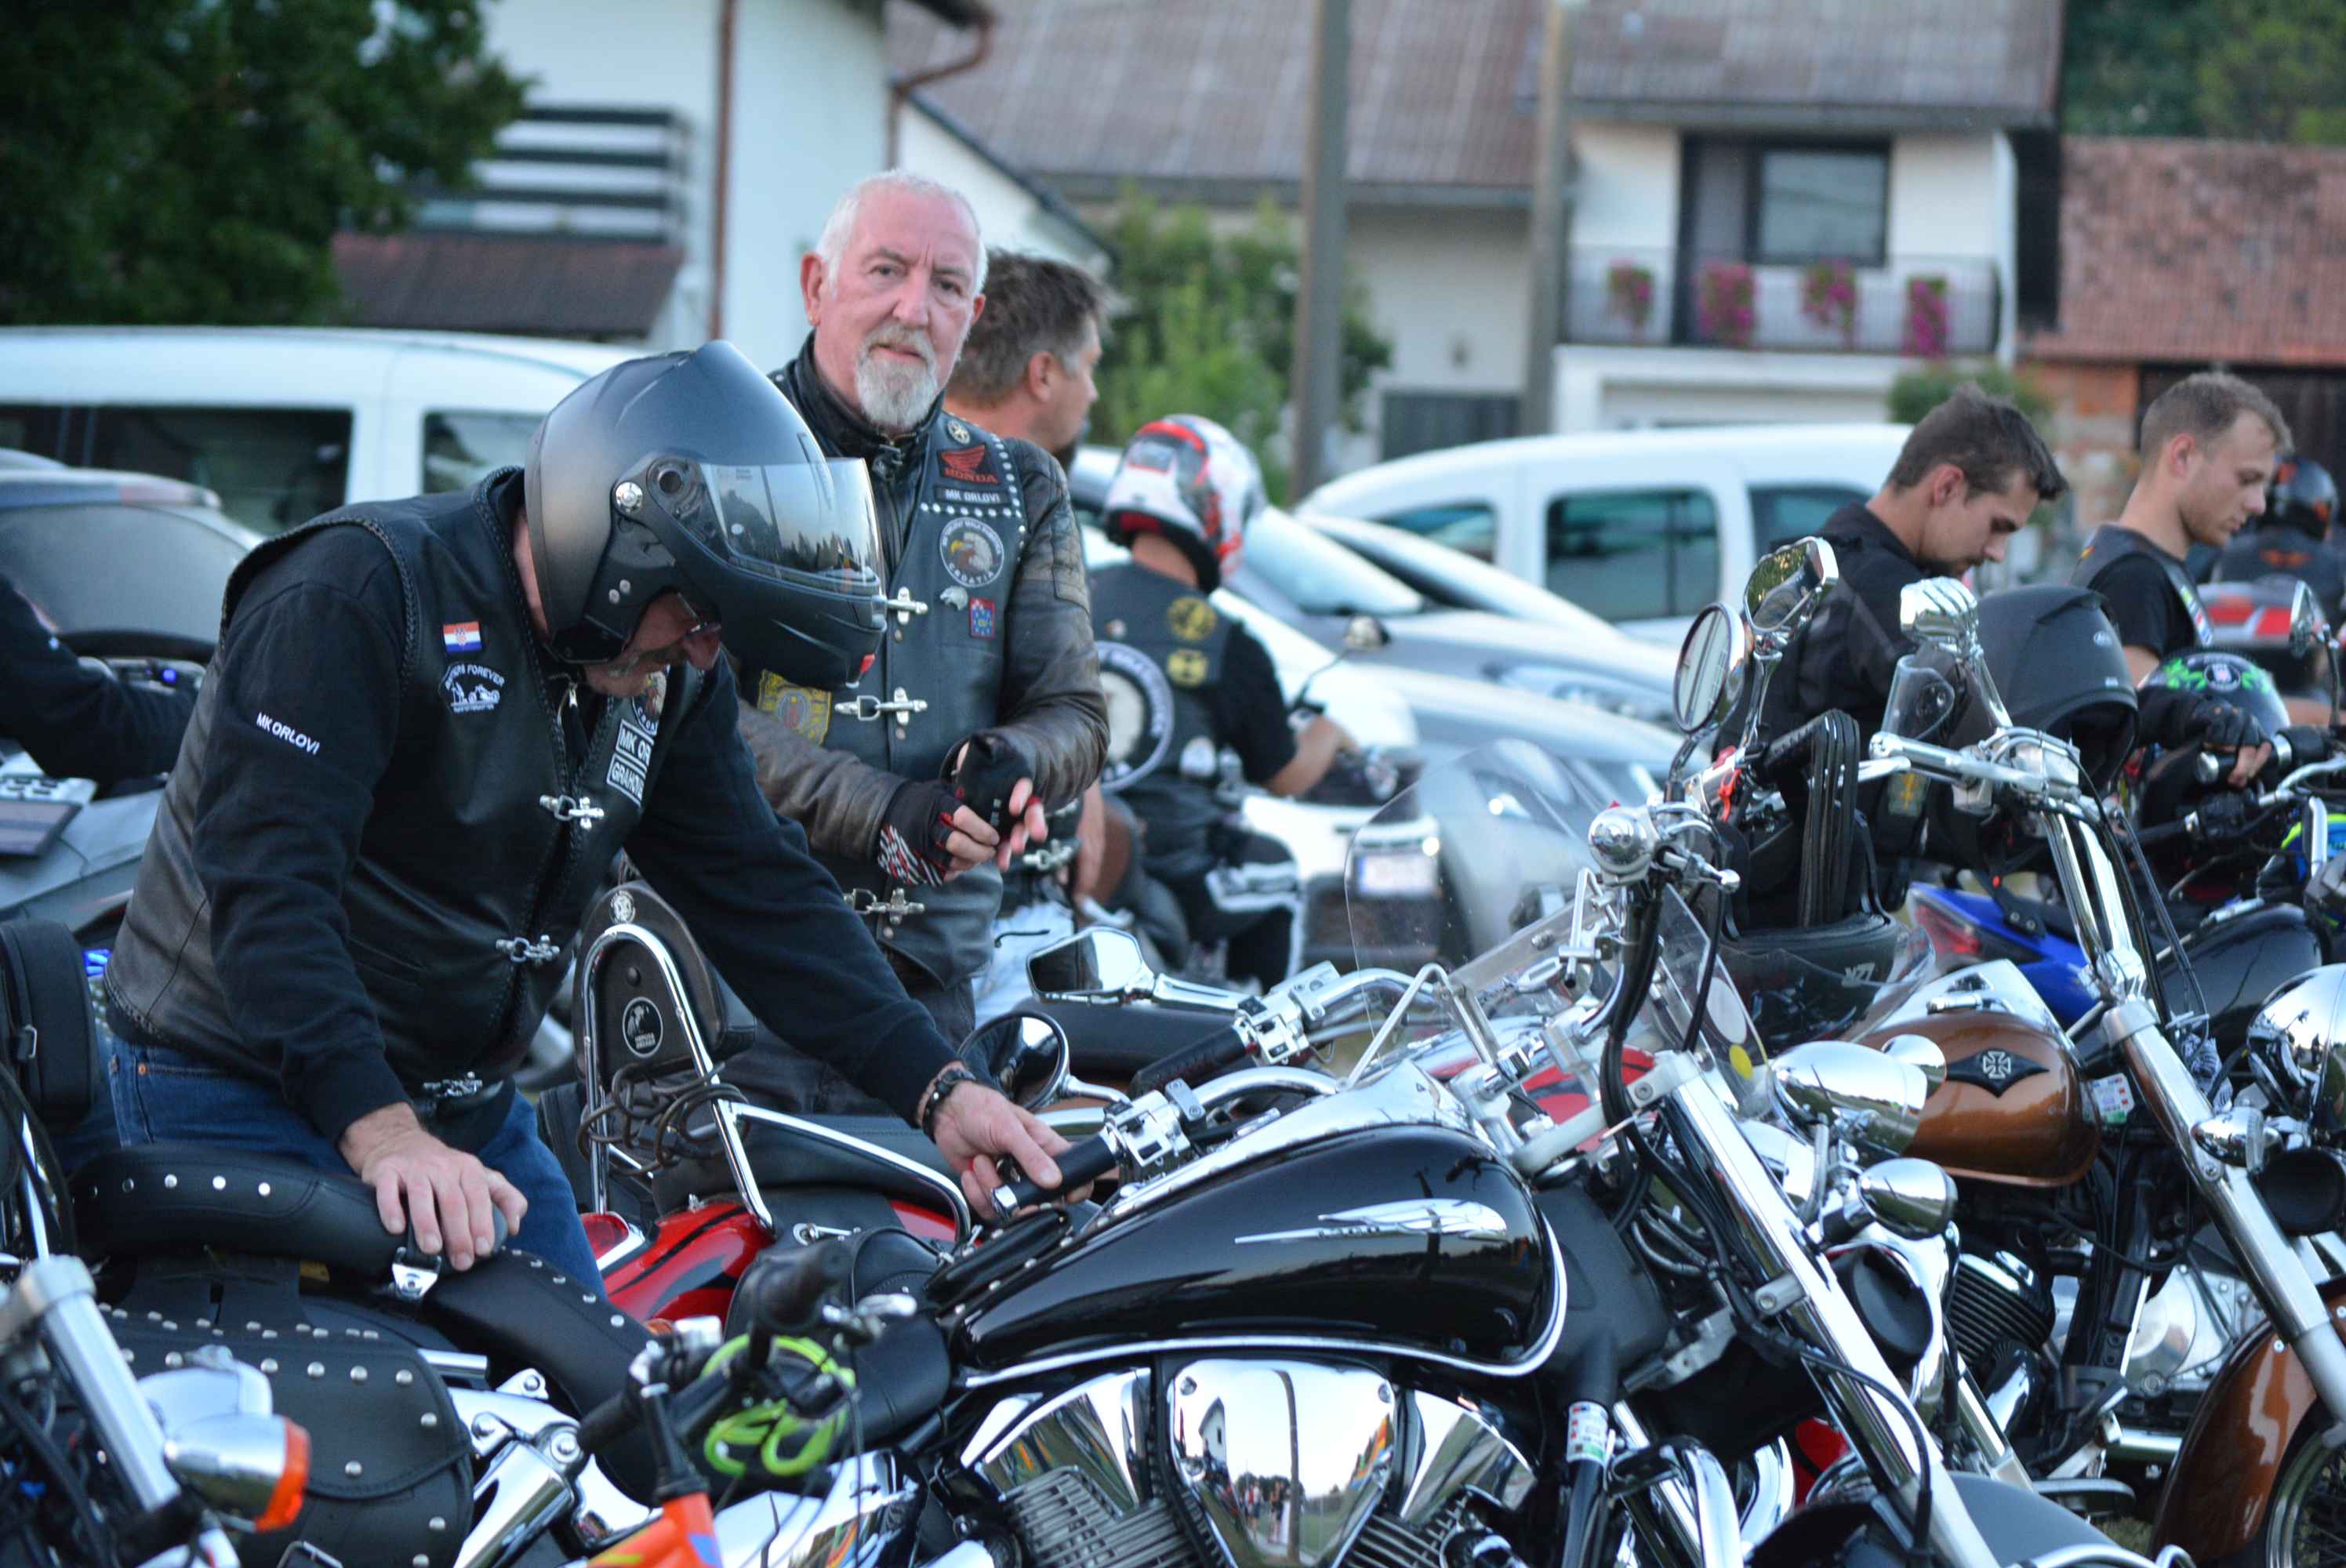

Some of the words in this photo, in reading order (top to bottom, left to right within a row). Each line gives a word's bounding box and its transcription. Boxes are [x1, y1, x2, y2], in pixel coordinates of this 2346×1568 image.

[944, 467, 998, 485] HONDA
[945, 488, 961, 501] MK
[964, 492, 1000, 503] ORLOVI
[949, 562, 994, 583] CROATIA
[467, 664, 505, 687] FOREVER
[256, 711, 273, 731] MK
[271, 721, 320, 755] ORLOVI
[619, 728, 638, 754] MK
